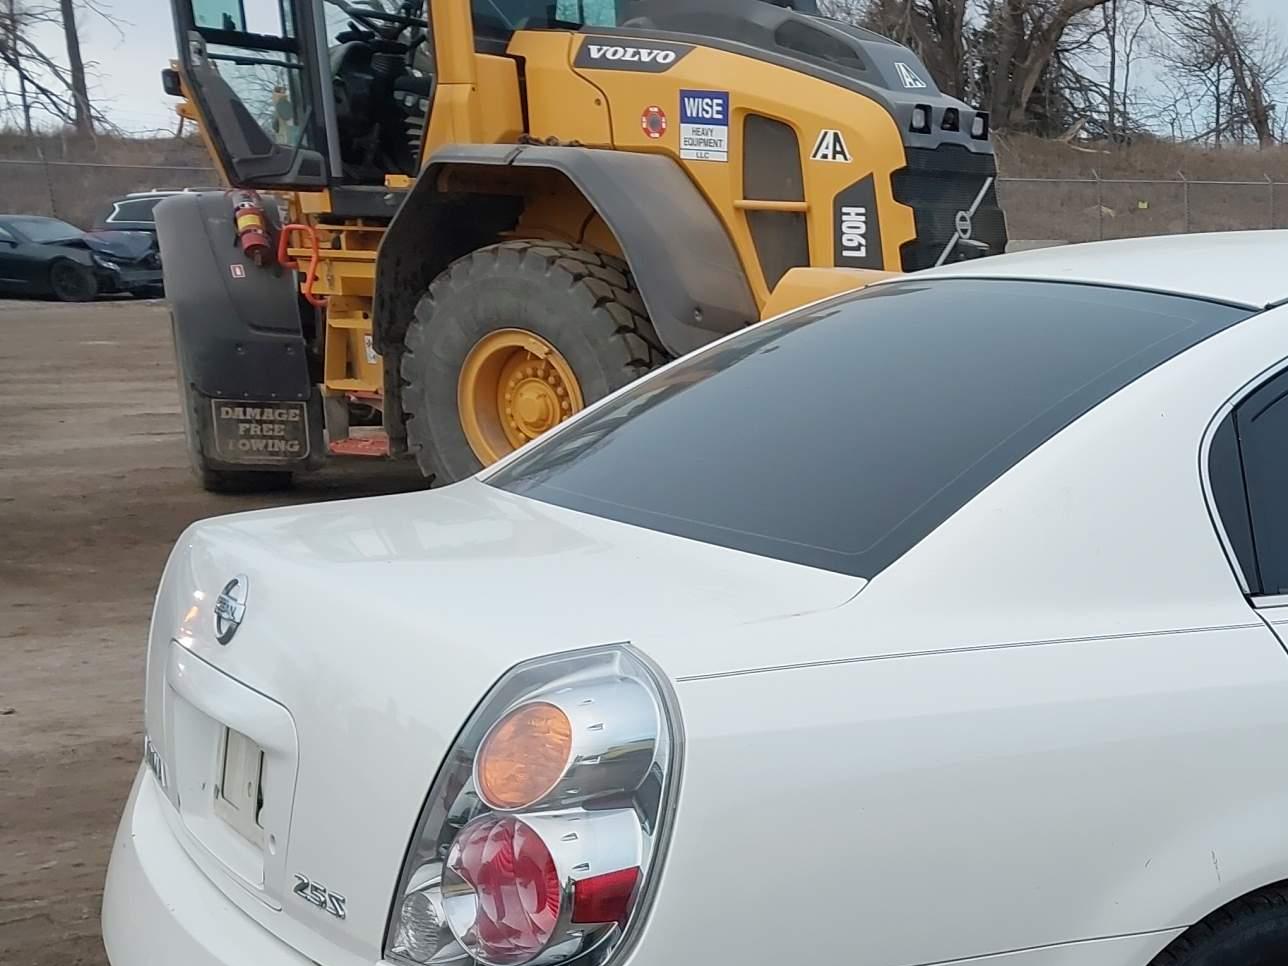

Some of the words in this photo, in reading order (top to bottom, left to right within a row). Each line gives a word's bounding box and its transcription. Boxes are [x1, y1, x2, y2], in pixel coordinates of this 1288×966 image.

[587, 45, 676, 64] VOLVO
[684, 97, 724, 119] WISE
[691, 127, 714, 136] HEAVY
[683, 137, 723, 148] EQUIPMENT
[841, 206, 867, 257] L90H
[220, 407, 300, 421] DAMAGE
[239, 423, 285, 436] FREE
